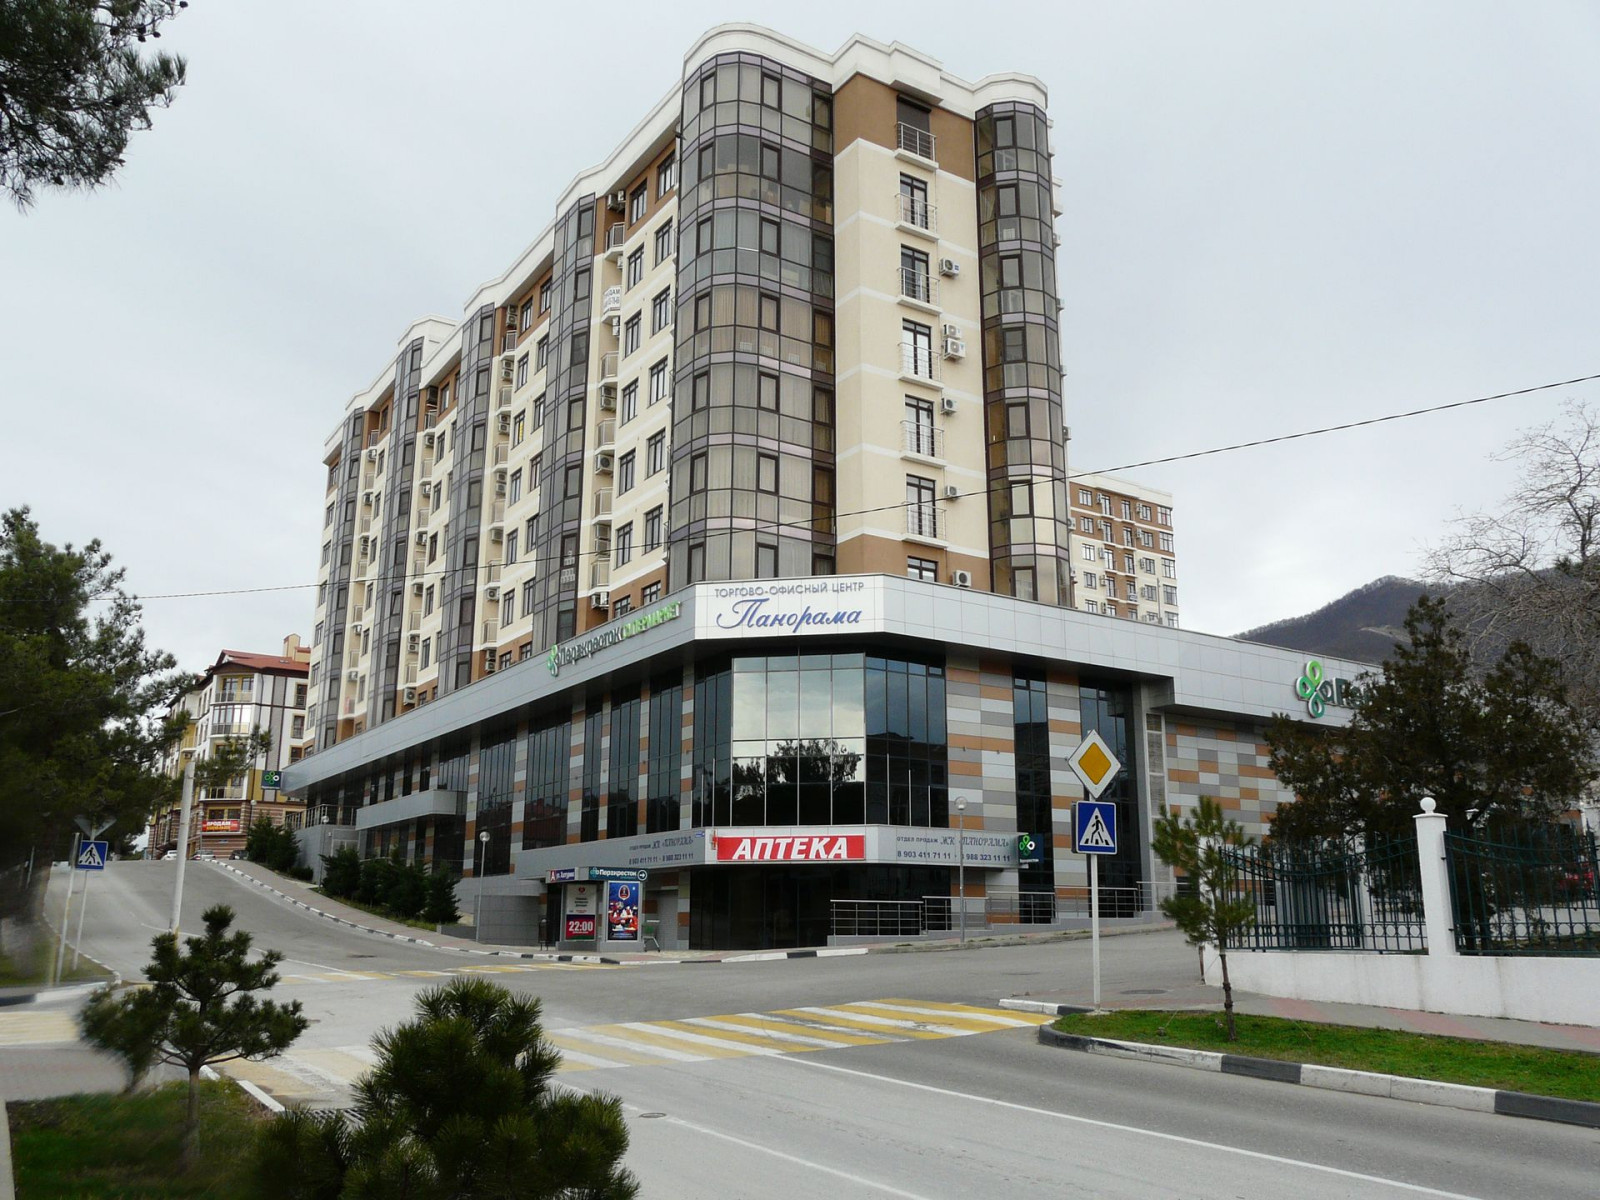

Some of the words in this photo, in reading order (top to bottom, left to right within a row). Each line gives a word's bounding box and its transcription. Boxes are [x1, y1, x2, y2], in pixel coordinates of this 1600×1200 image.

[714, 582, 828, 598] ТОРГОВО-ОФИСНЫЙ
[832, 582, 865, 595] ЦЕНТР
[716, 597, 863, 633] Панорама
[732, 837, 849, 860] АПТЕКА
[897, 850, 902, 858] 8
[903, 850, 917, 859] 903
[917, 851, 931, 859] 411
[932, 851, 941, 859] 71
[943, 852, 951, 860] 11
[993, 854, 1001, 862] 11
[1002, 854, 1011, 862] 11
[568, 920, 594, 932] 22:00
